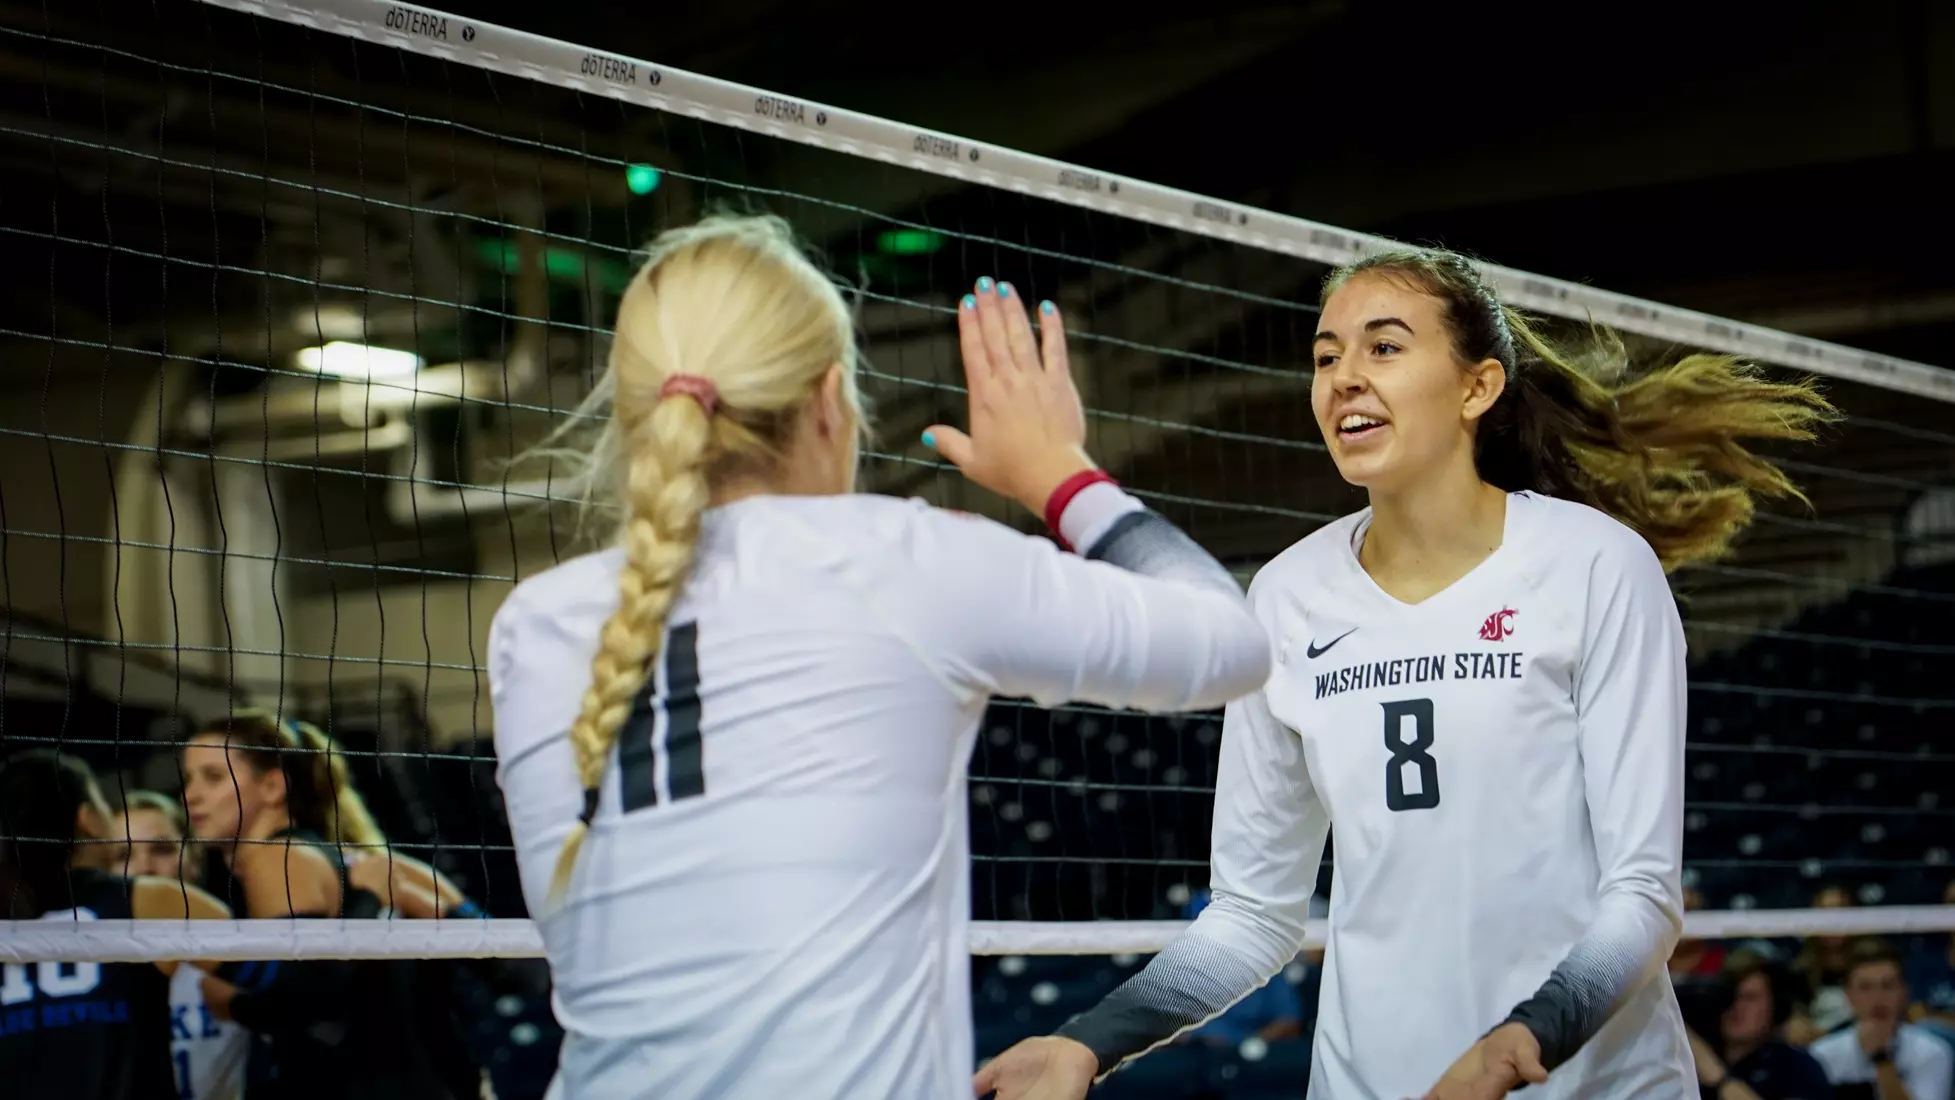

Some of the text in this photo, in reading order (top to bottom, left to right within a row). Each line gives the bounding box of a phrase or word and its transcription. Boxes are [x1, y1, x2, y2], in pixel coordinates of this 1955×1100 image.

[618, 617, 706, 815] 11
[1315, 652, 1523, 700] WASHINGTON STATE
[1379, 697, 1441, 812] 8
